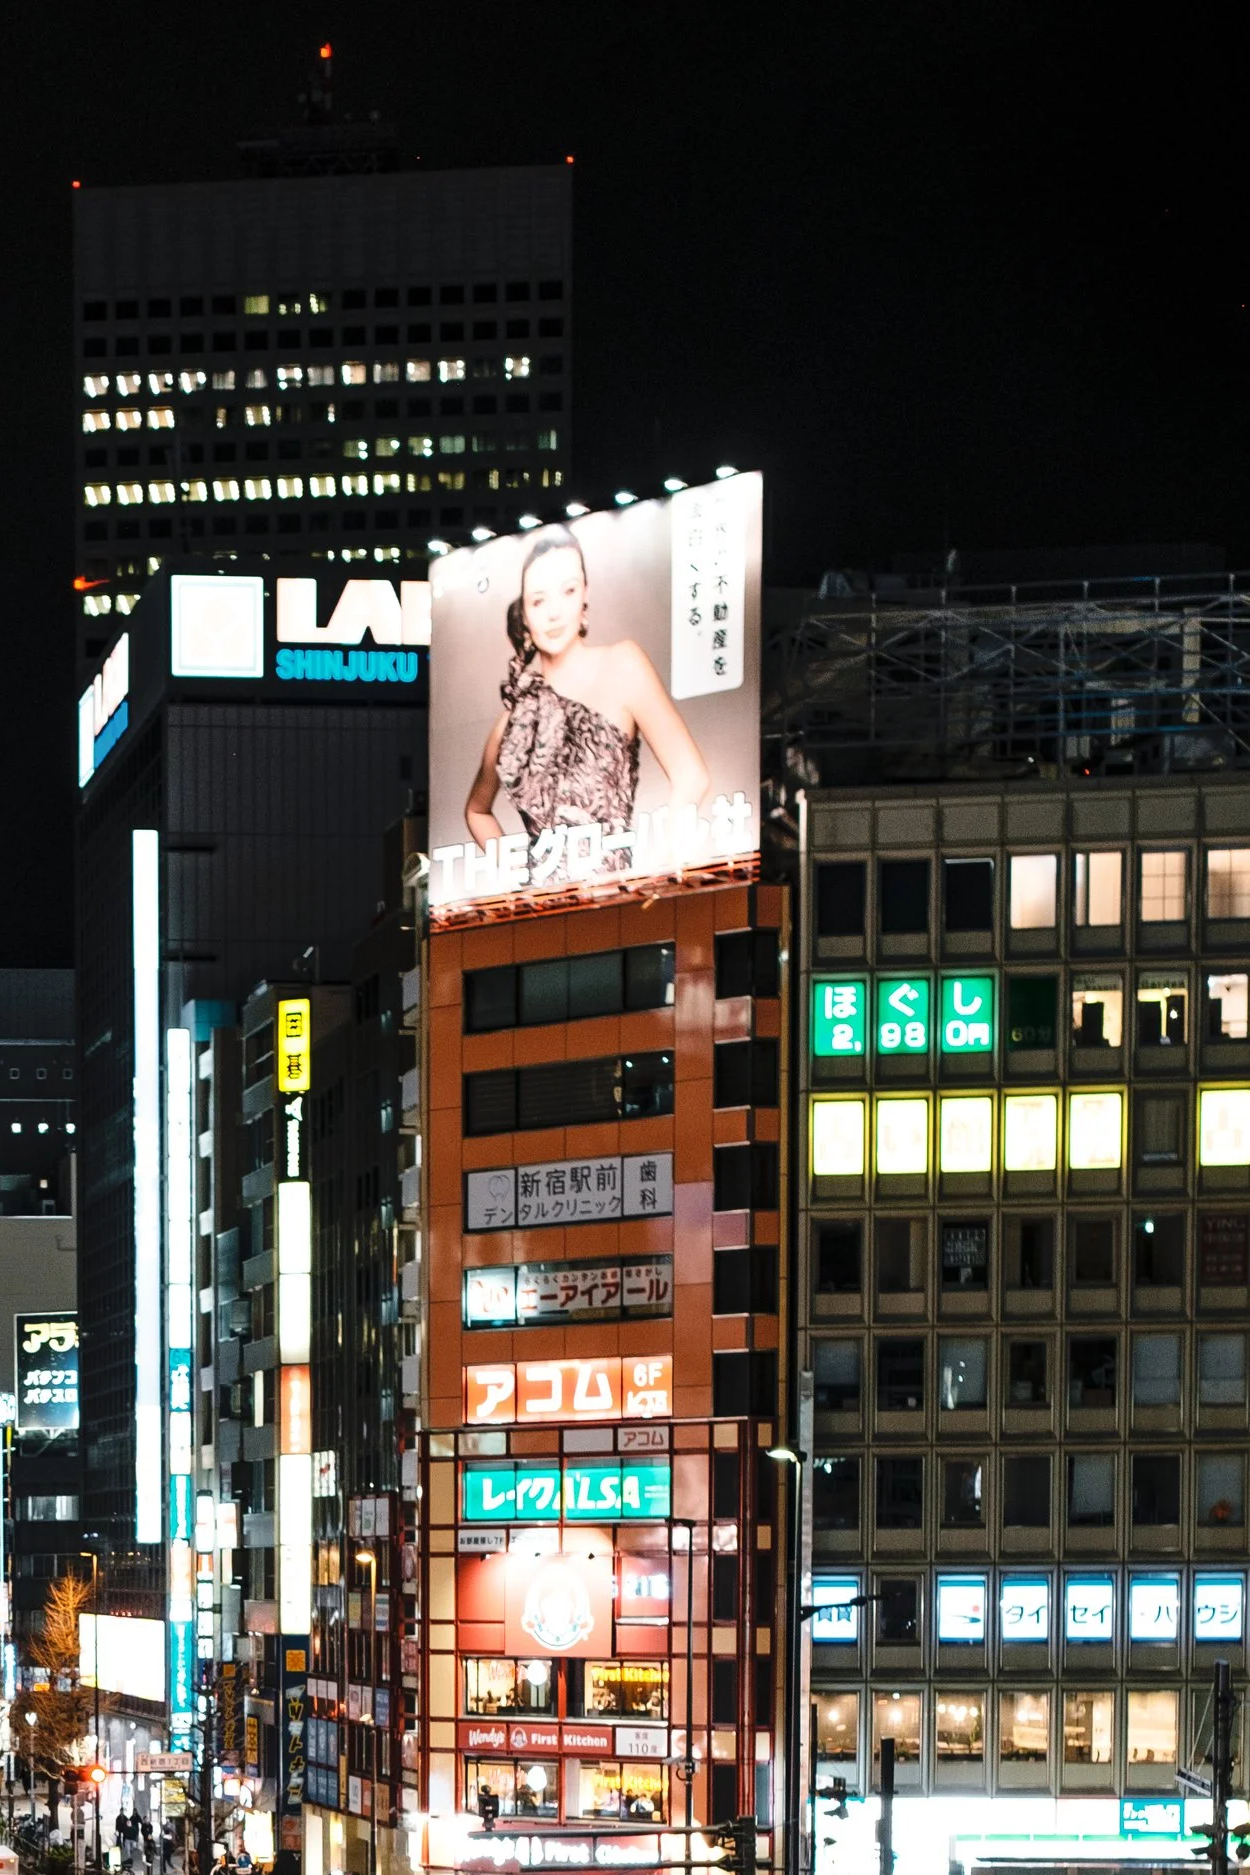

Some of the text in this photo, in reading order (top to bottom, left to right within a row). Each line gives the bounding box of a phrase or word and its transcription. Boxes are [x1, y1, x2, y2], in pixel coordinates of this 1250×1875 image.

[275, 648, 419, 682] SHINJUKU
[432, 791, 753, 890] THEグローバル社
[824, 982, 982, 1019] ほぐし
[520, 1163, 618, 1198] 新宿駅前
[639, 1160, 658, 1211] 歯科
[484, 1195, 622, 1226] デンタルクリニック
[23, 1369, 78, 1386] パチンコ
[475, 1364, 613, 1417] アコム
[23, 1387, 78, 1405] パチスロ
[623, 1430, 664, 1447] アコム
[531, 1733, 558, 1745] First
[563, 1734, 608, 1747] Kitchen
